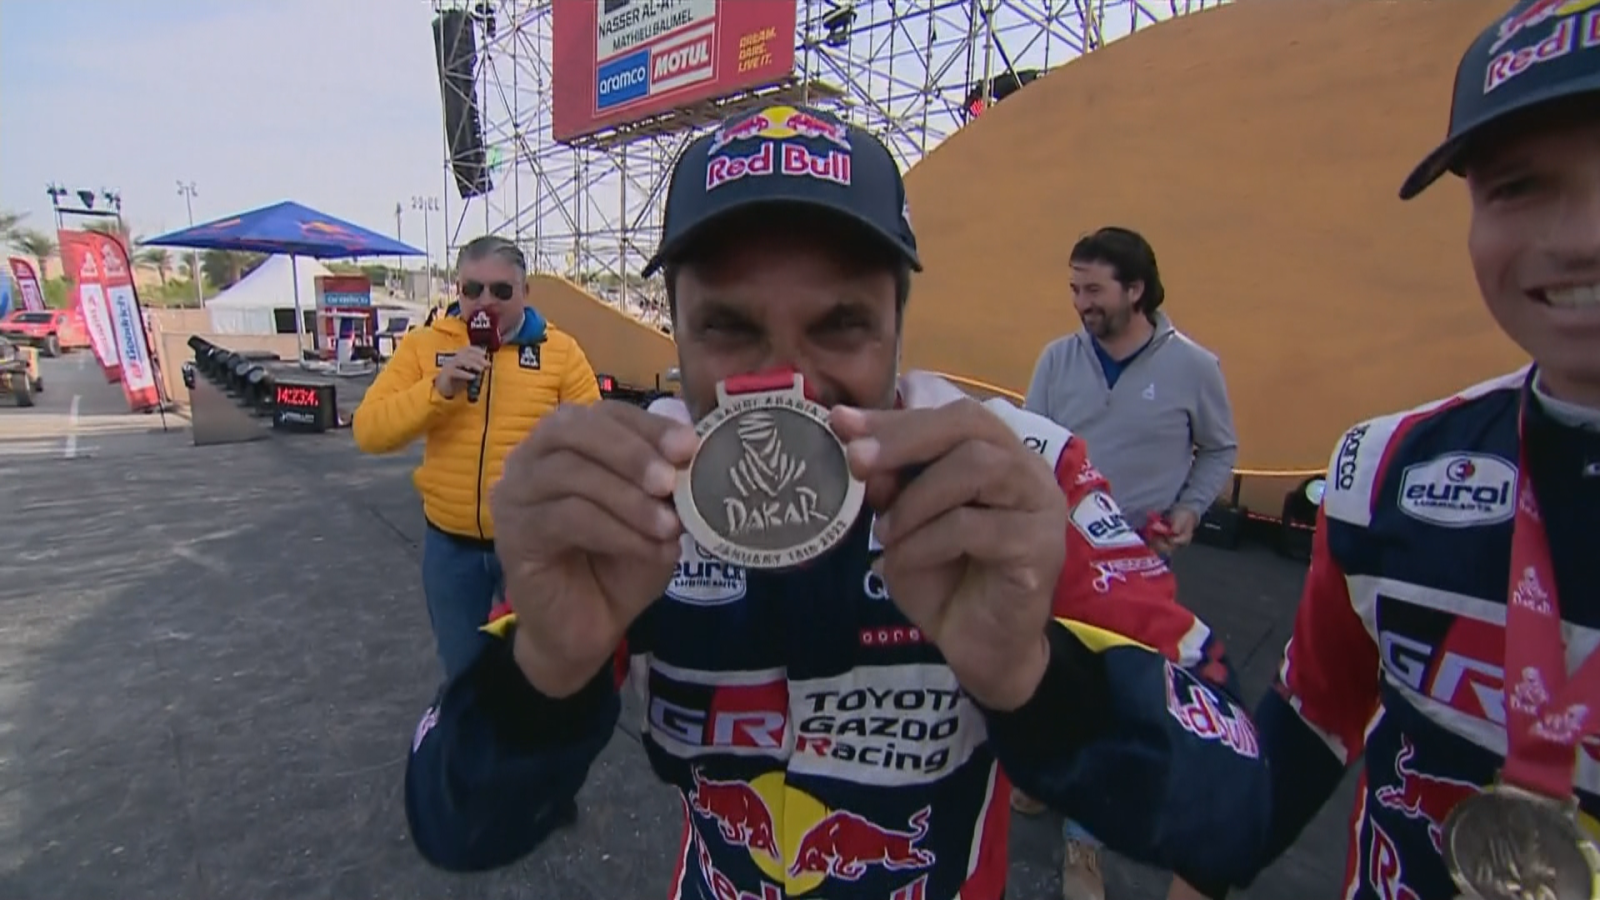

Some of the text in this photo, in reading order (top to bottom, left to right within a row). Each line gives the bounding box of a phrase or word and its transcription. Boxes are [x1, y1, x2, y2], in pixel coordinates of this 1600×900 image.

[598, 8, 640, 40] NASSER
[613, 8, 693, 51] MATHIEU BAUMEL
[653, 41, 709, 80] MOTUL
[1484, 14, 1575, 94] Red
[600, 68, 646, 94] aramco
[706, 142, 851, 192] Red Bull
[723, 486, 830, 534] DAKAR
[1406, 481, 1510, 506] eurol
[714, 542, 782, 565] JANUARY
[863, 628, 920, 644] oore
[650, 699, 784, 748] GR
[800, 714, 959, 742] GAZOO
[795, 732, 951, 775] Racing
